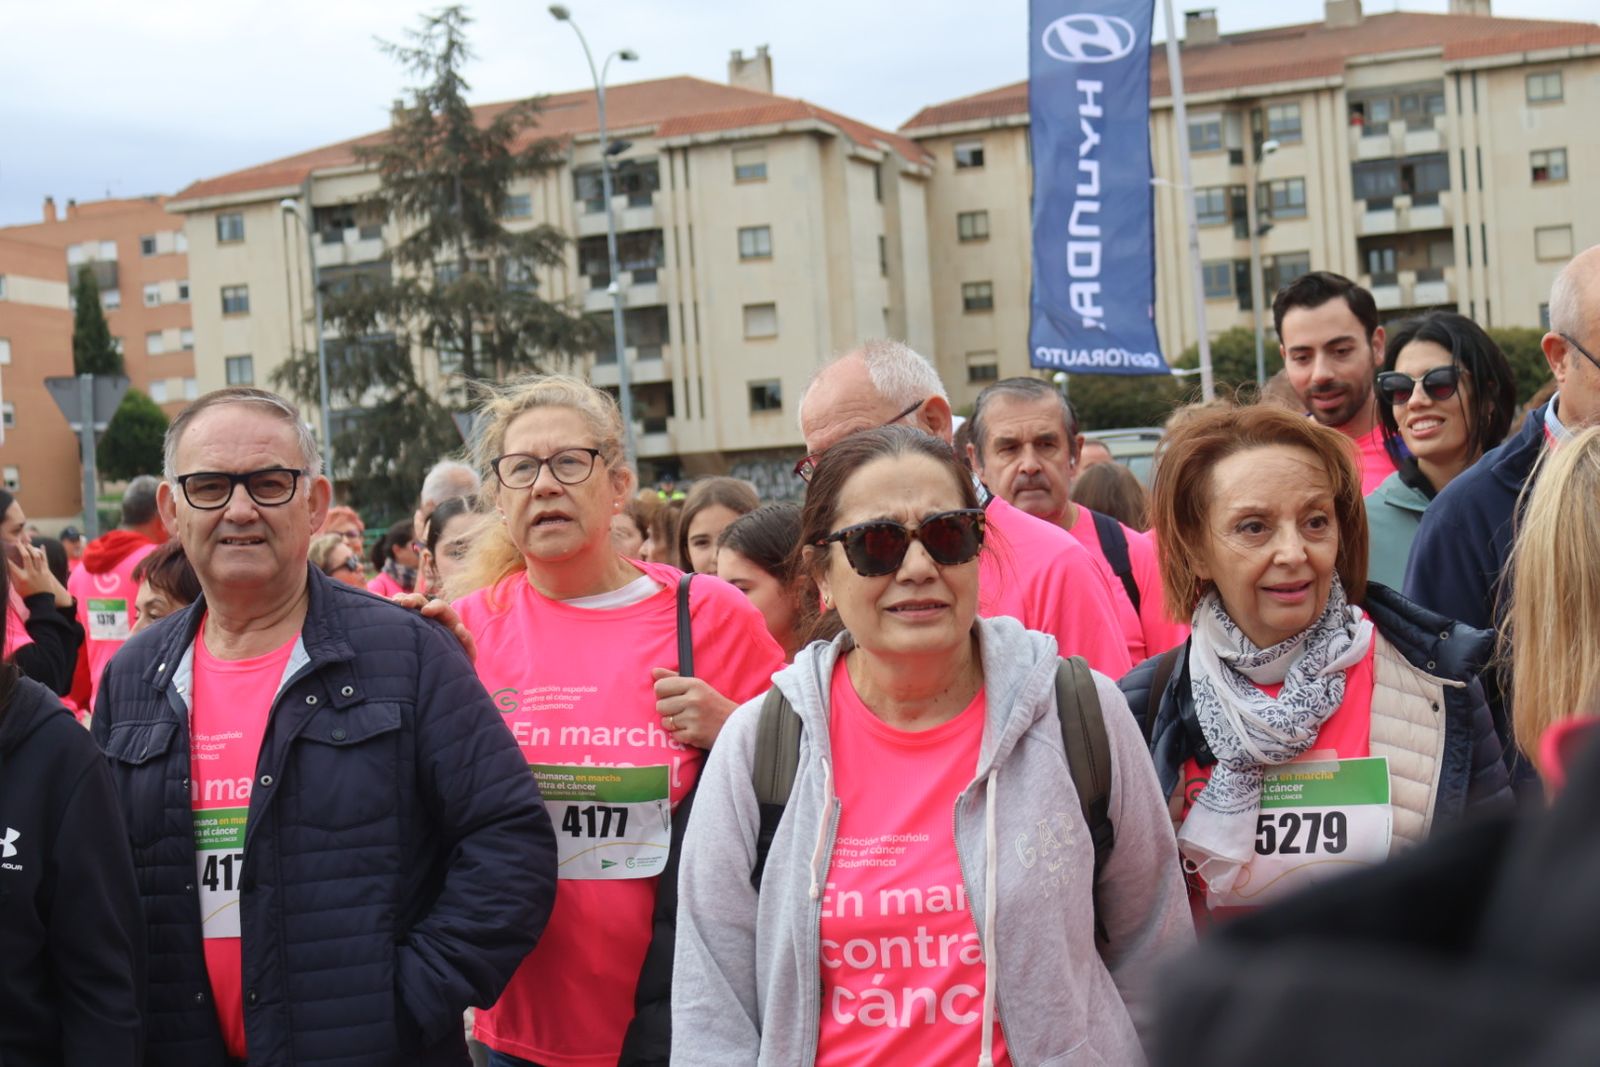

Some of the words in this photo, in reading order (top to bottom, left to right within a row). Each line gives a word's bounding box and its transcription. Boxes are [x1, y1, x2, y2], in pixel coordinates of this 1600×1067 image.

[512, 722, 551, 747] En
[557, 782, 566, 790] el
[566, 782, 597, 791] cáncer
[1269, 782, 1304, 792] cáncer
[562, 805, 628, 838] 4177
[1254, 811, 1348, 856] 5279
[870, 844, 907, 855] cáncer
[880, 832, 929, 844] española
[1014, 811, 1074, 870] GAP
[202, 854, 244, 892] 417
[838, 858, 896, 869] Salamanca
[820, 926, 986, 970] contra
[832, 973, 981, 1028] cánc
